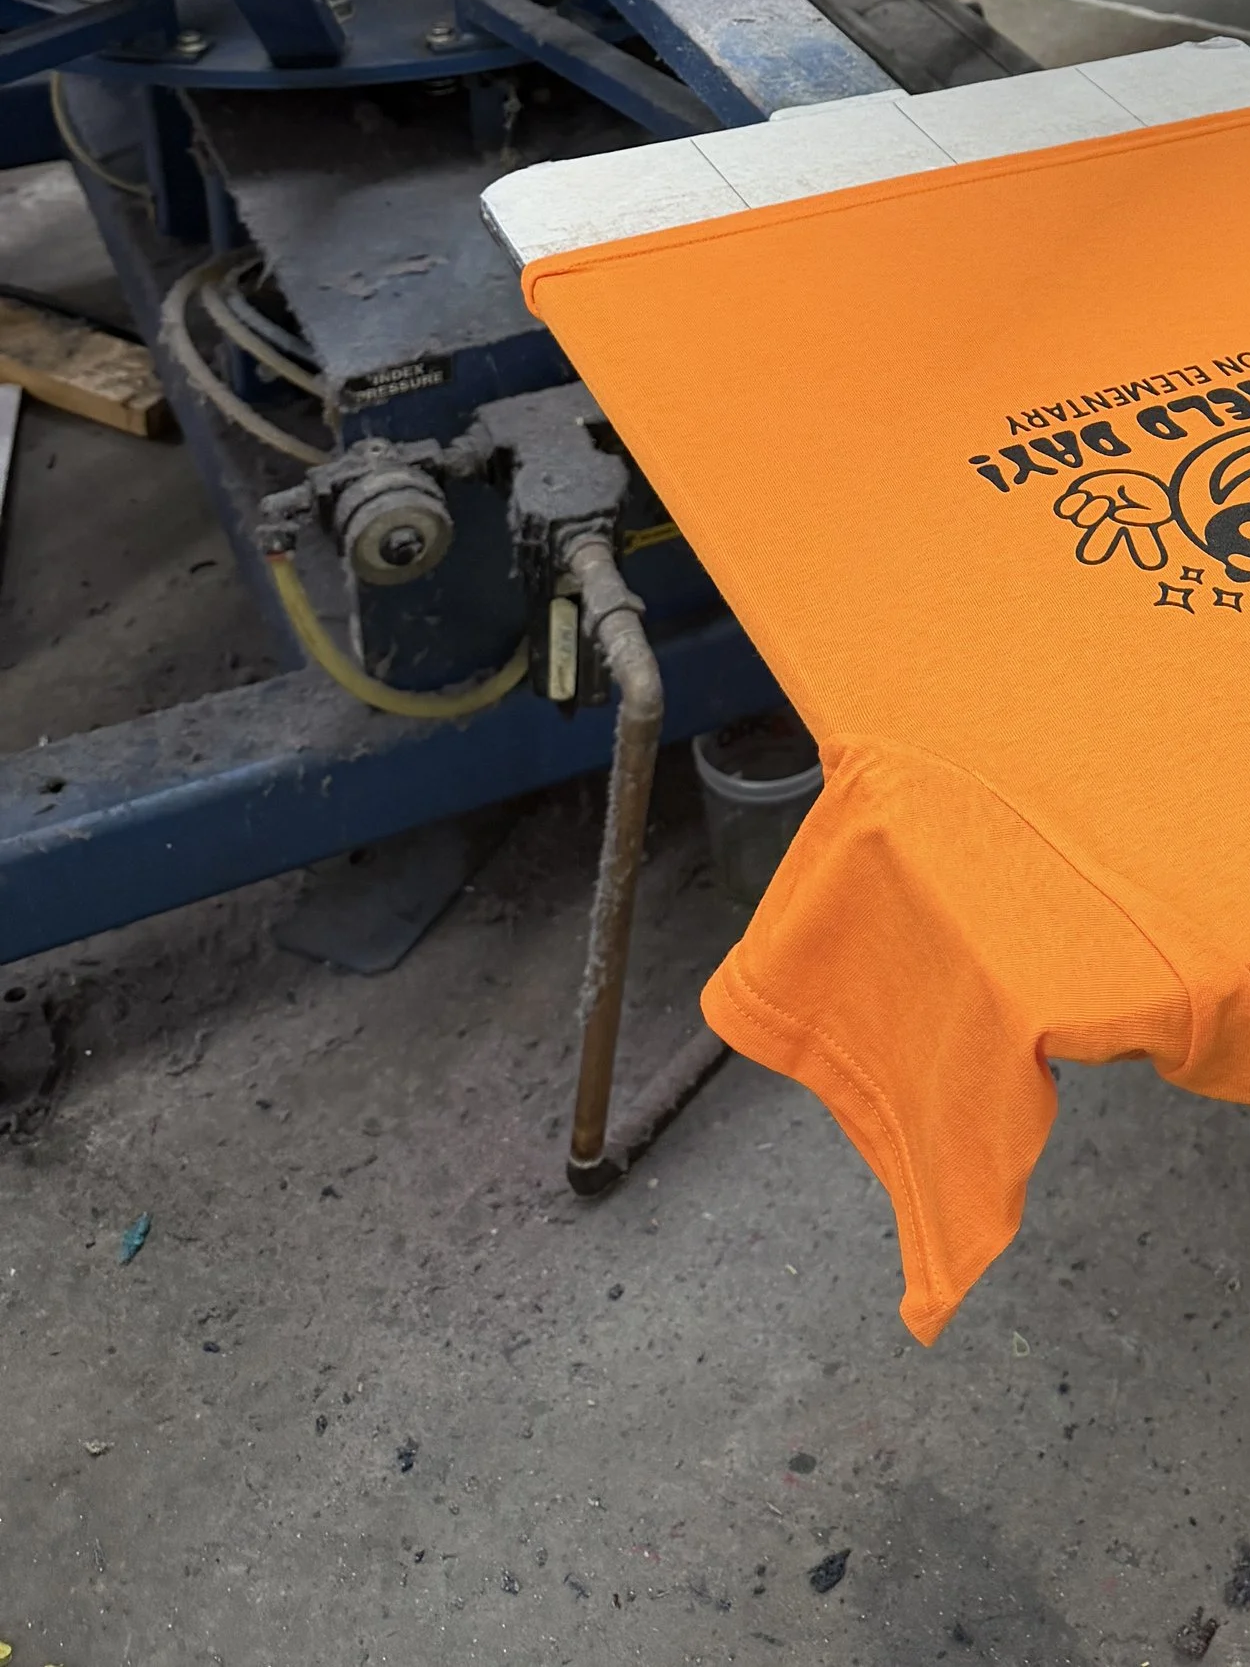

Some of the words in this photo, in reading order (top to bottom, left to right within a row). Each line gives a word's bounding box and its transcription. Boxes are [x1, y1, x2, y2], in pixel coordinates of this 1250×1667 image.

[372, 363, 425, 385] INDEX
[1005, 363, 1212, 435] ELEMENTARY
[967, 420, 1132, 494] DAY!
